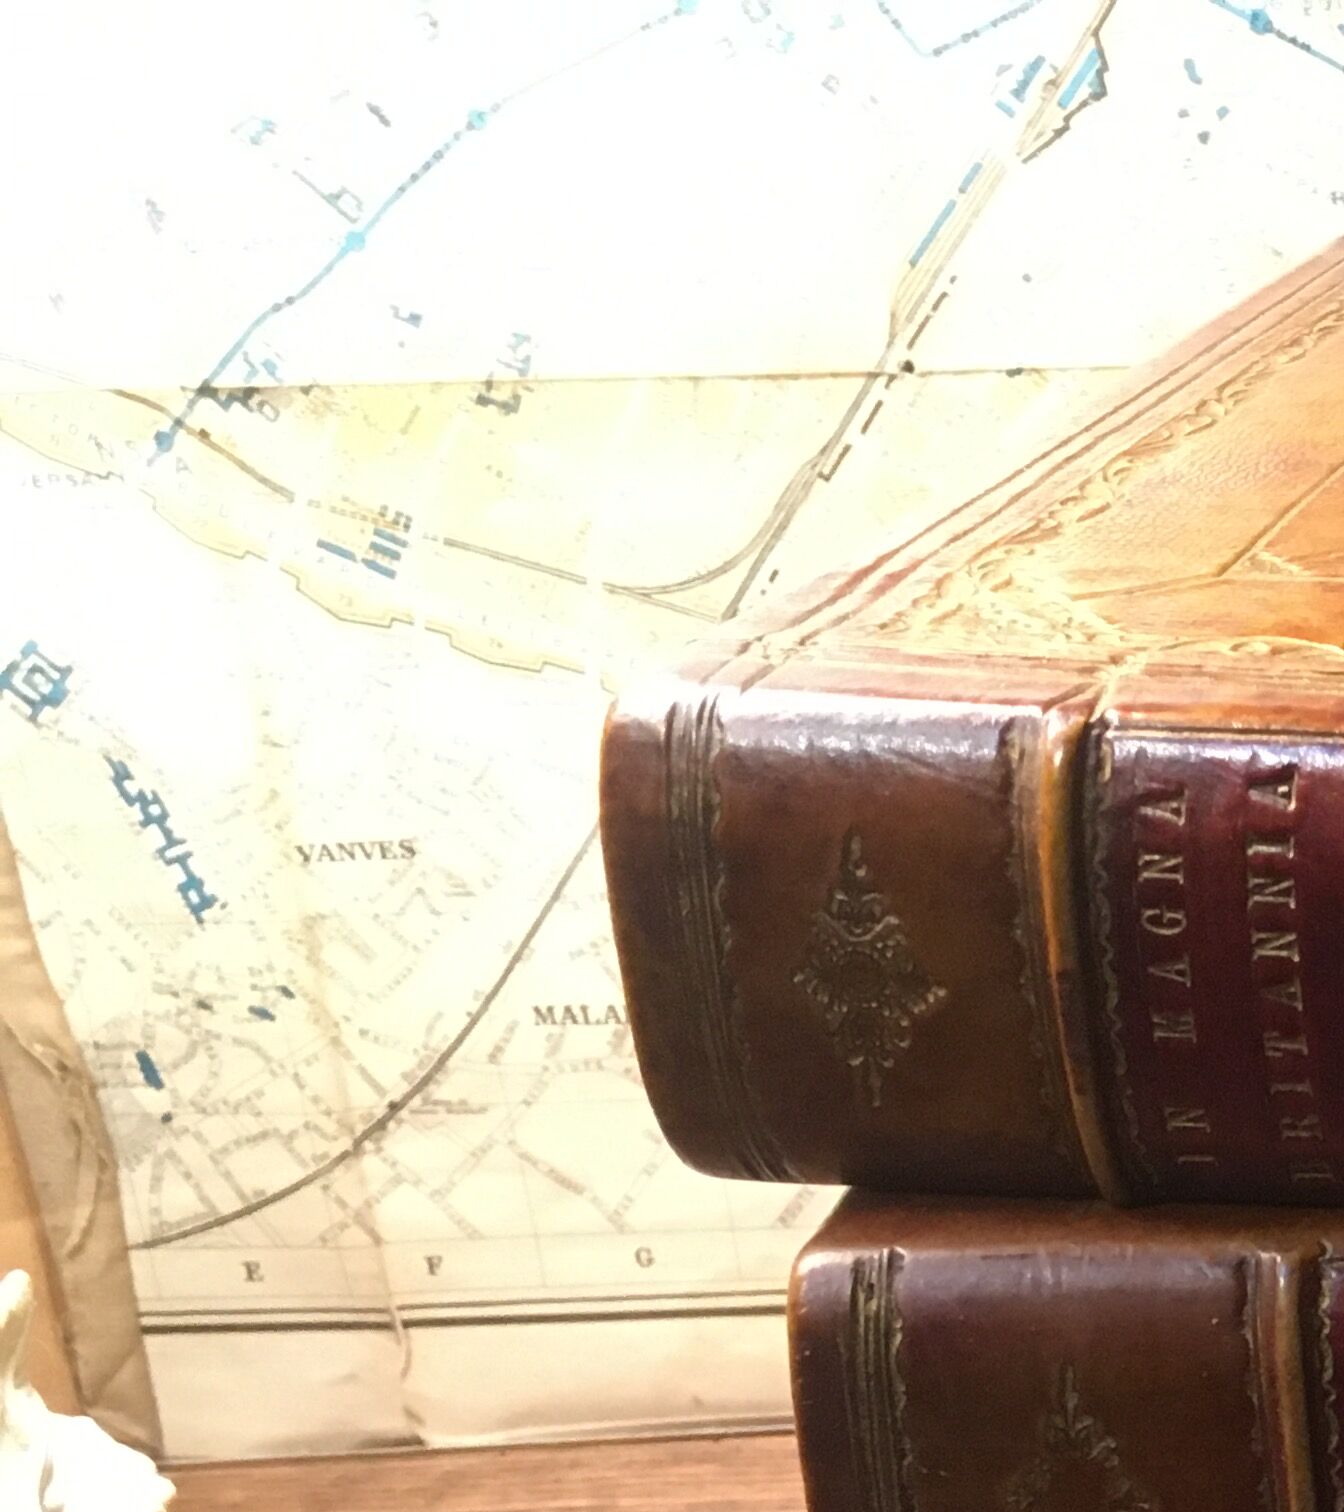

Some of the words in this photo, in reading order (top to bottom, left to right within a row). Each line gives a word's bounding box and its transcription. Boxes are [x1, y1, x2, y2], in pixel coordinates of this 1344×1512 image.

[294, 837, 417, 866] VANVES
[1136, 785, 1198, 1045] MAGNA
[1246, 762, 1335, 1183] BRITANNIA
[425, 1254, 444, 1276] F
[634, 1246, 656, 1268] G
[242, 1260, 265, 1284] E
